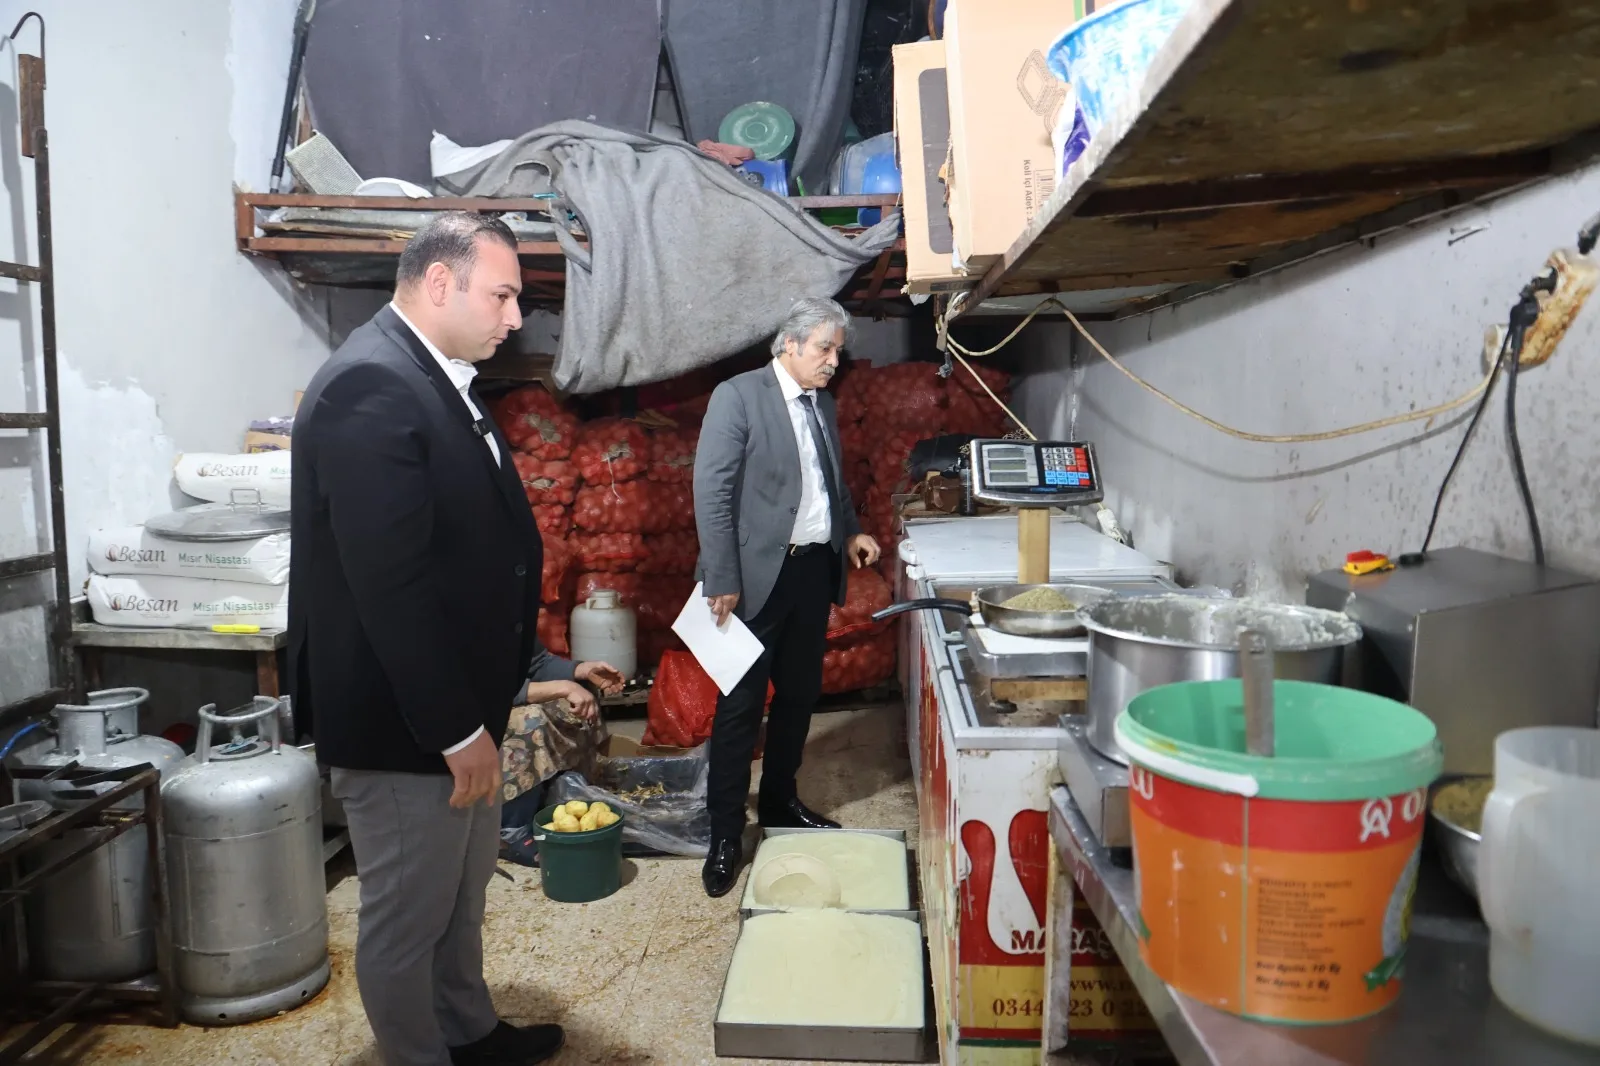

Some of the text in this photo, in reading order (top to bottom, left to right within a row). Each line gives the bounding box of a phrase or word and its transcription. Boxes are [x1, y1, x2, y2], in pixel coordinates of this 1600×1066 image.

[1023, 159, 1032, 175] Koli
[1025, 190, 1033, 209] Adet
[208, 463, 259, 477] Besan
[118, 545, 166, 562] Besan
[122, 594, 179, 612] Besan
